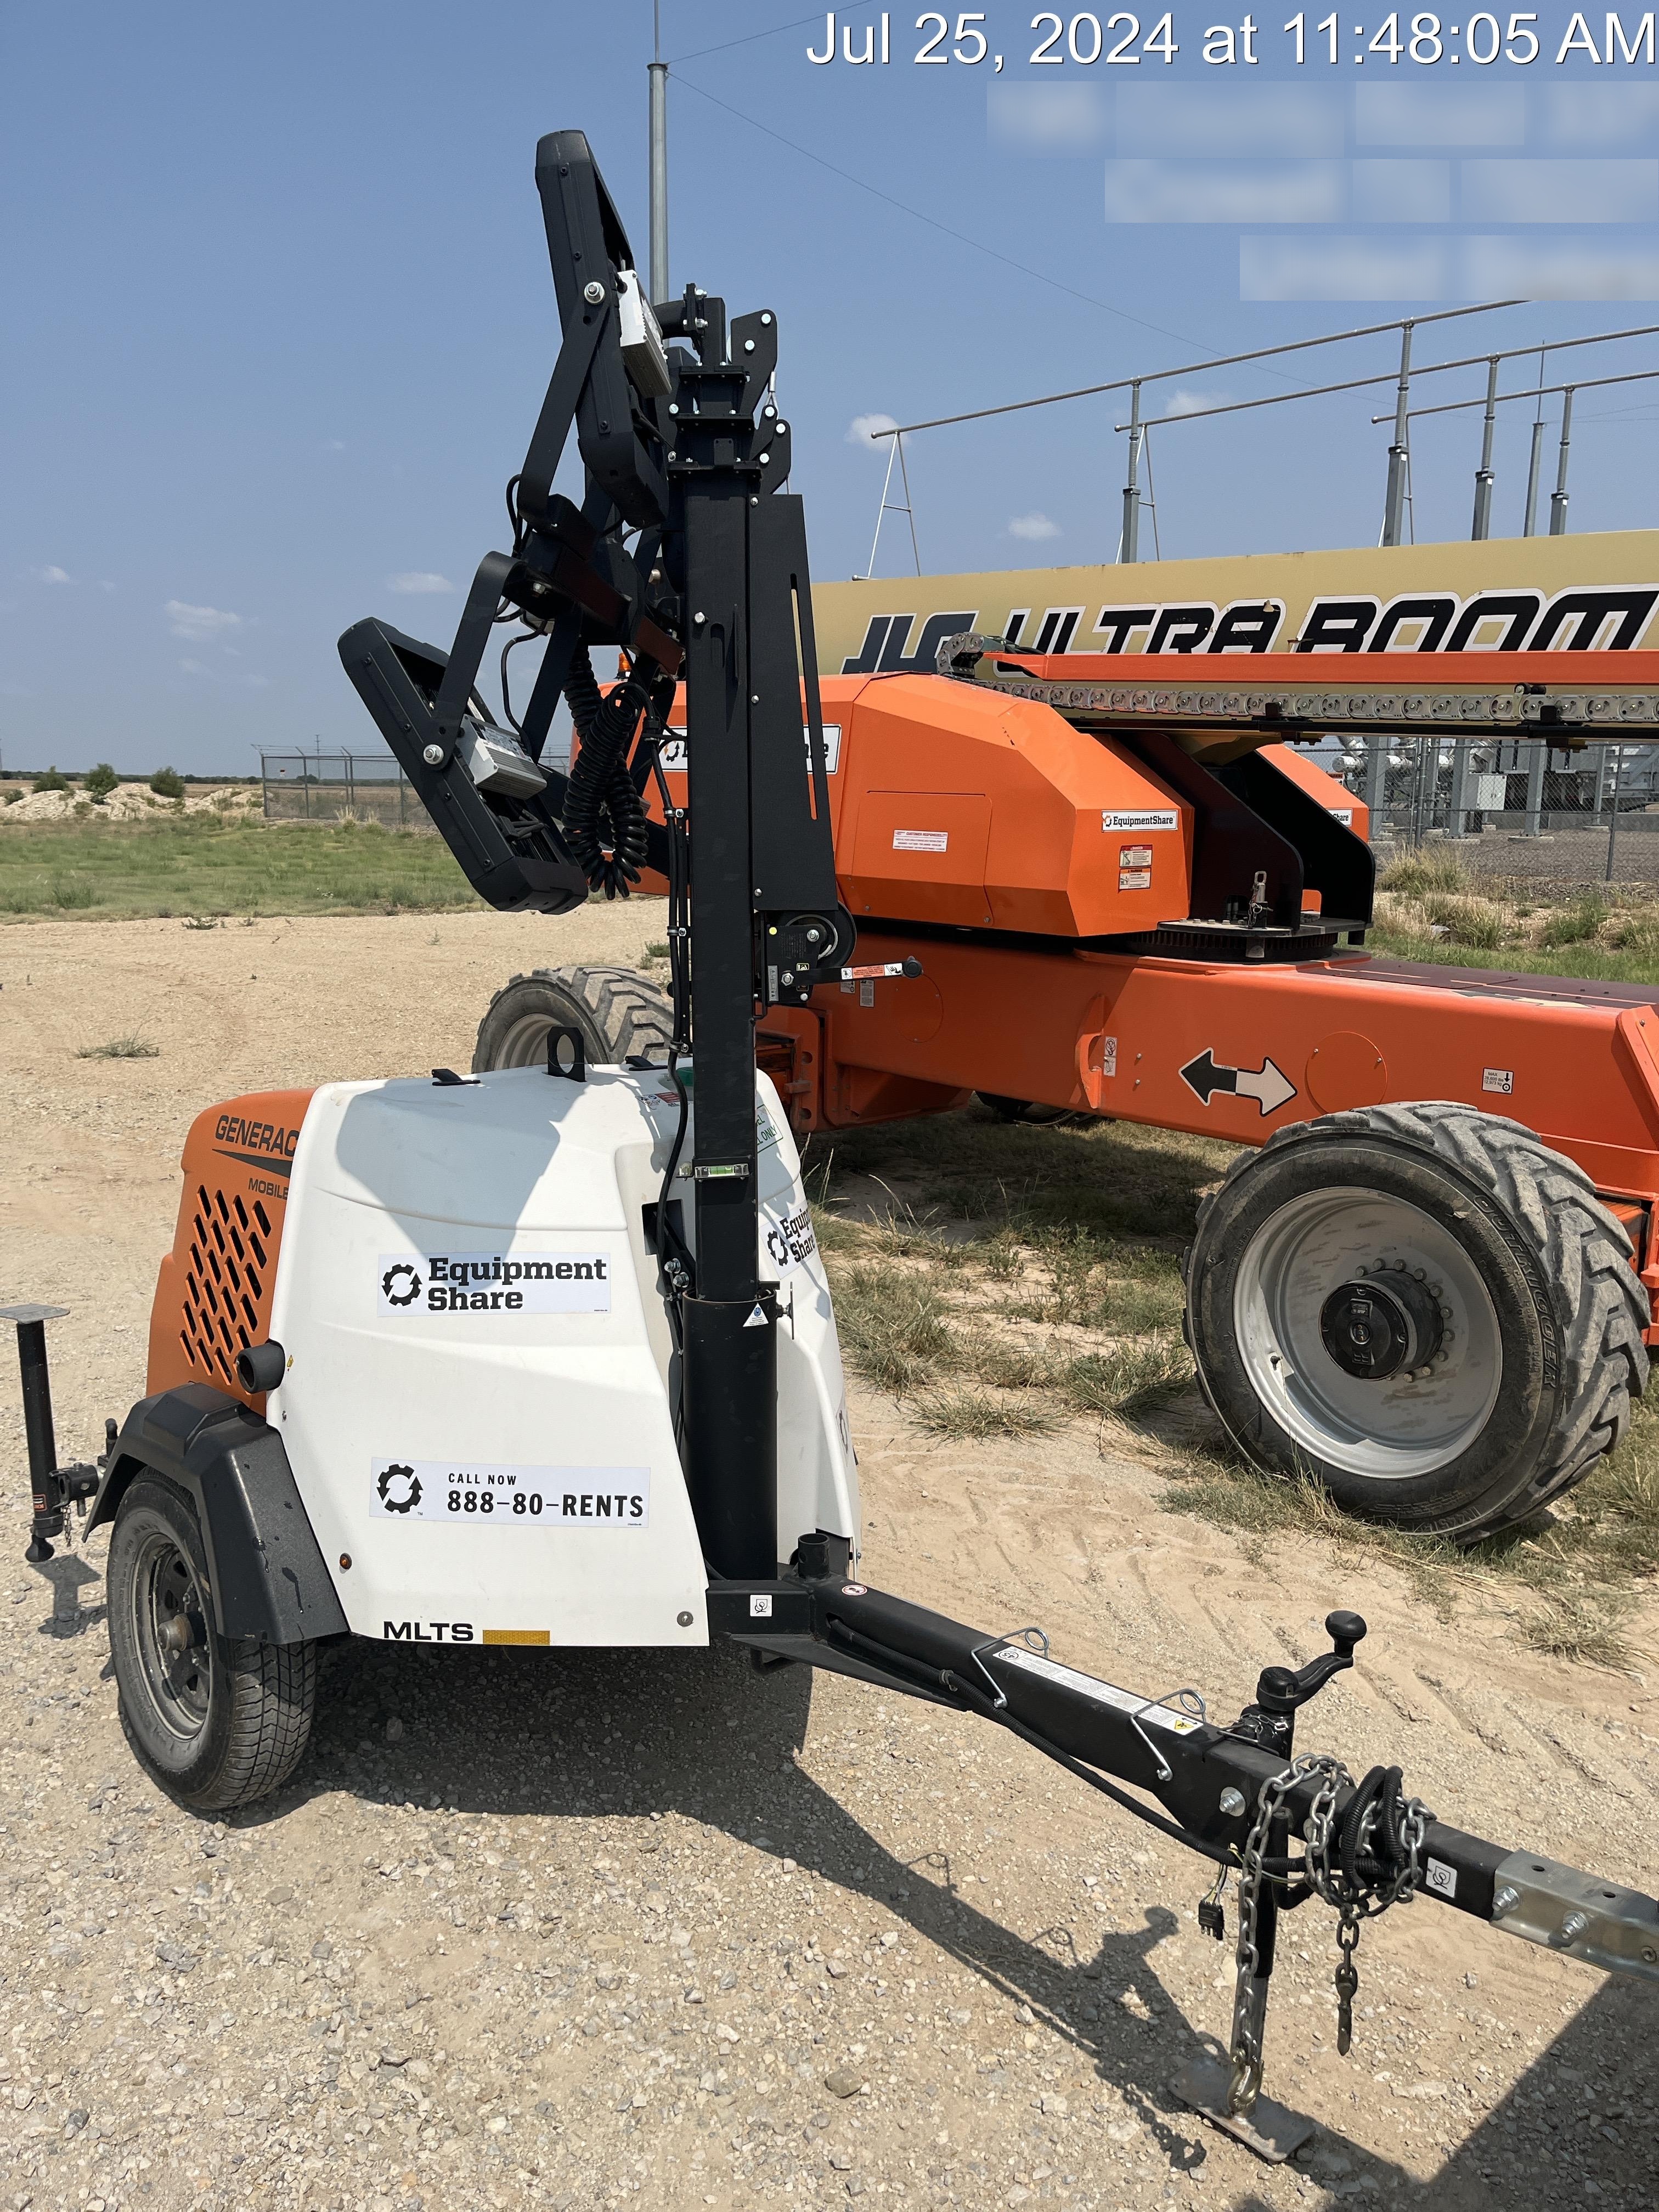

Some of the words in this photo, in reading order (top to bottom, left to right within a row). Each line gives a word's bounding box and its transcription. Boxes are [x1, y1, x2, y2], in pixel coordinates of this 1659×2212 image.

[993, 597, 1284, 678] ULTRA
[1293, 583, 1658, 653] BOOM
[1113, 815, 1173, 827] EquipmentShare
[215, 1115, 300, 1157] GENERAC
[761, 1125, 777, 1141] ONLY
[780, 1208, 811, 1239] Equip
[790, 1234, 815, 1263] Share
[428, 1257, 607, 1286] Equipment
[428, 1287, 523, 1311] Share
[448, 1473, 481, 1485] CALL
[488, 1474, 517, 1486] NOW
[447, 1490, 644, 1517] 888-80-RENTS
[383, 1621, 473, 1641] MLTS
